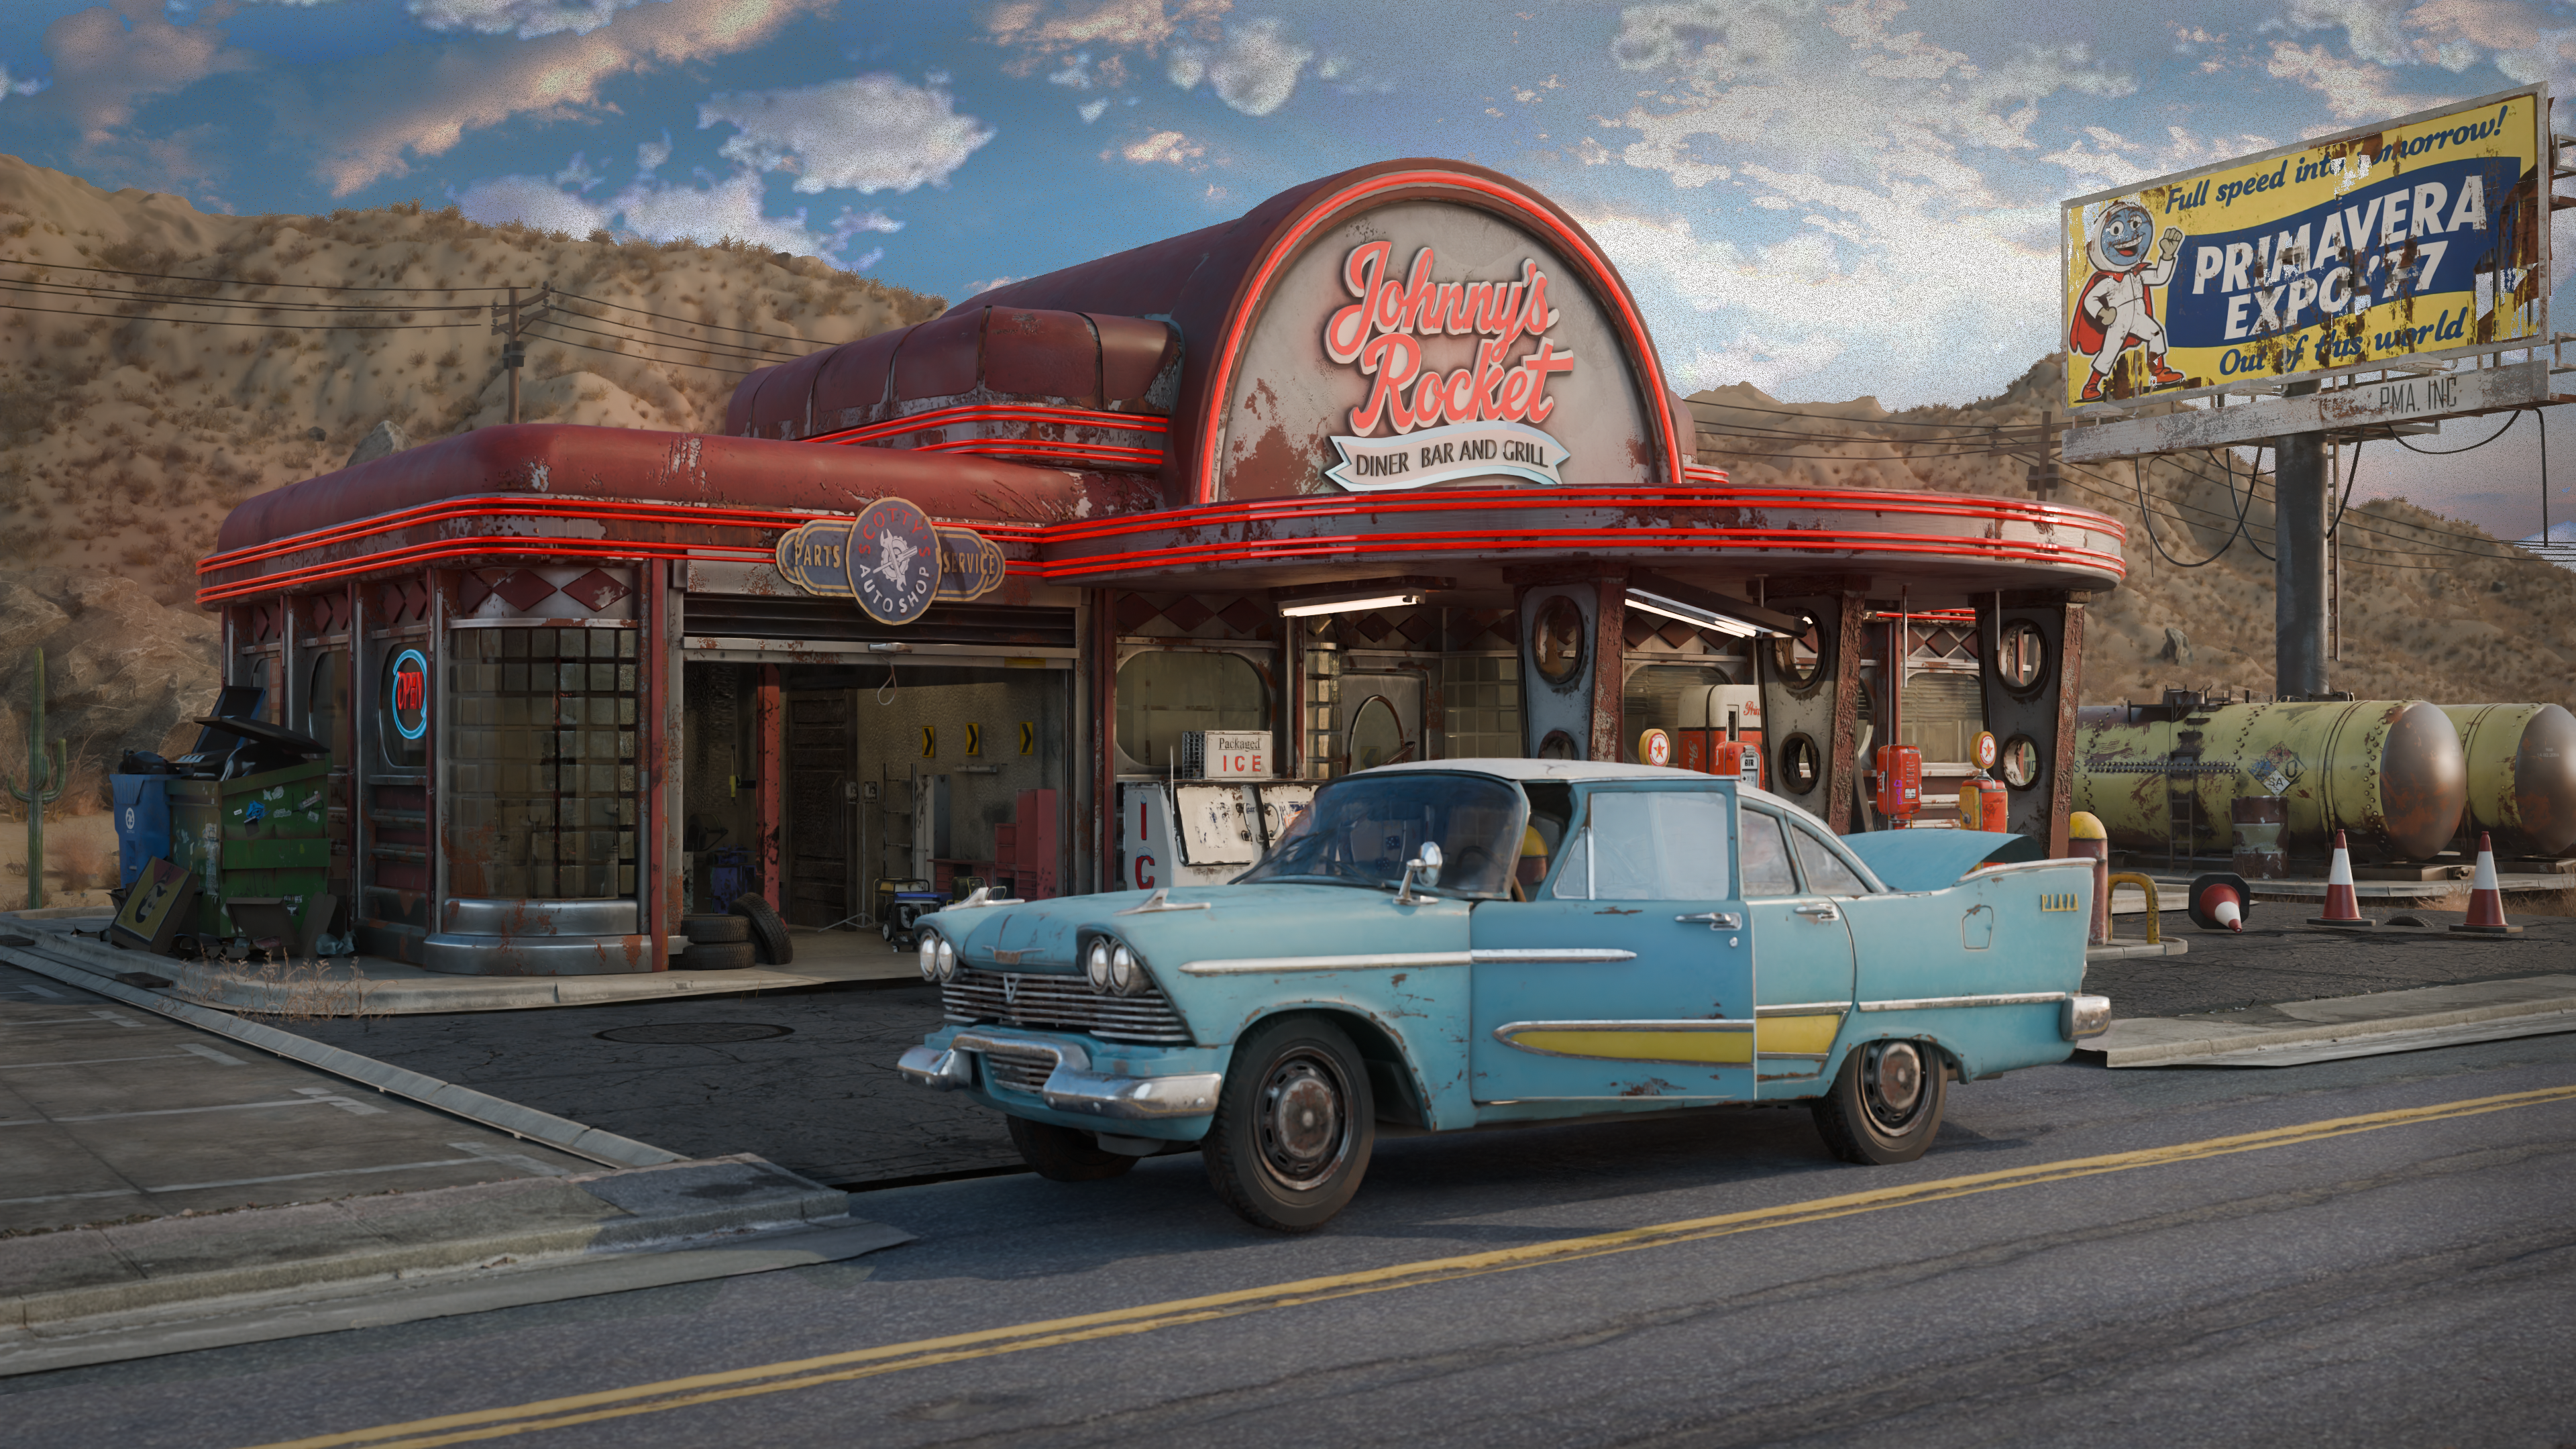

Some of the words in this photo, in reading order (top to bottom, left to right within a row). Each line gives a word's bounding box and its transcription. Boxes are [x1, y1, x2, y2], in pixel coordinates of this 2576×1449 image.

[2165, 178, 2210, 214] Full
[2216, 160, 2288, 207] speed
[2357, 105, 2508, 168] morrow!
[2192, 175, 2487, 295] PRIMAVERA
[1324, 241, 1560, 364] Johnny's
[2223, 266, 2353, 340] EXPO
[2219, 347, 2268, 376] Out
[1348, 332, 1574, 437] Rocket
[2428, 376, 2457, 411] INC
[1356, 451, 1410, 476] DINER
[1421, 442, 1455, 468] BAR
[1459, 439, 1497, 462] AND
[1503, 439, 1549, 468] GRILL
[858, 507, 931, 557] SCOTTY'S
[794, 544, 841, 568] PARTS
[943, 551, 996, 575] SERVICE
[397, 671, 423, 710] OPEN
[1218, 737, 1261, 753] Packaged
[1223, 753, 1262, 772] ICE
[1744, 759, 1754, 767] AIR
